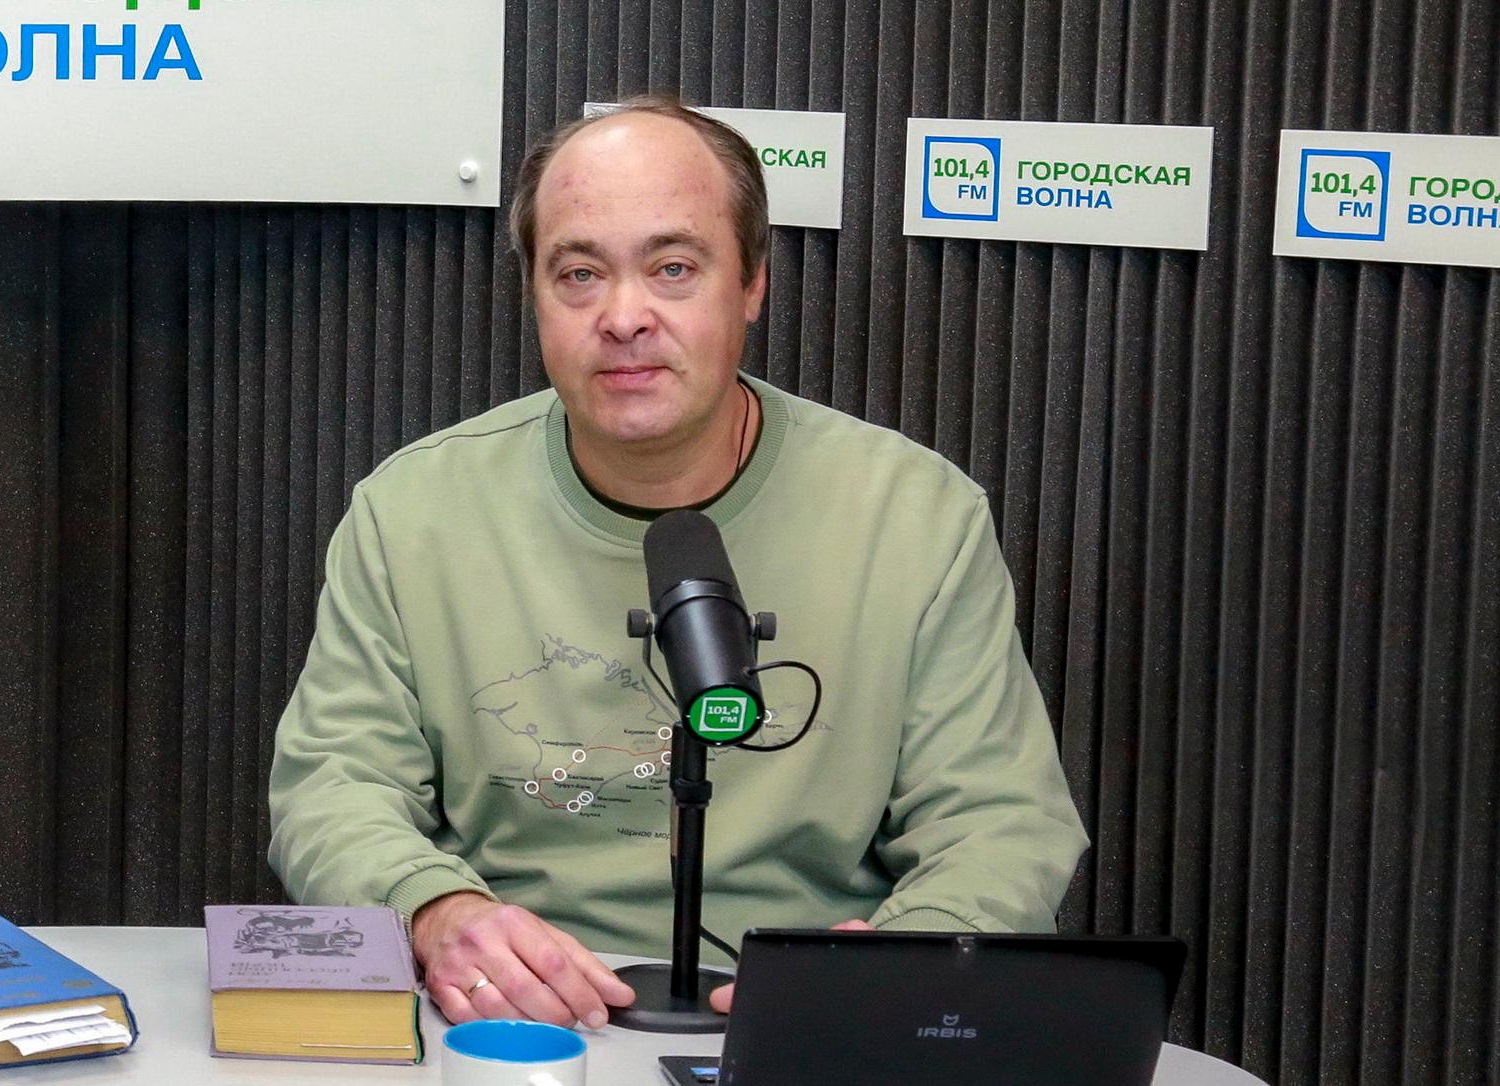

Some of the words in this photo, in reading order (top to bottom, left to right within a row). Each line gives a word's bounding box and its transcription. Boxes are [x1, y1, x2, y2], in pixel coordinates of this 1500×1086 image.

[756, 147, 827, 168] СКАЯ
[934, 157, 989, 179] 101,4
[1017, 159, 1191, 186] ГОРОДСКАЯ
[958, 183, 987, 201] FM
[1312, 171, 1376, 196] 101,4
[1409, 176, 1500, 204] ГОРО
[1016, 185, 1113, 209] ВОЛНА
[1338, 200, 1375, 219] FM
[1407, 204, 1500, 229] ВОЛН
[706, 705, 740, 717] 101,4
[719, 715, 739, 725] FM
[917, 1027, 977, 1039] IRBIS
